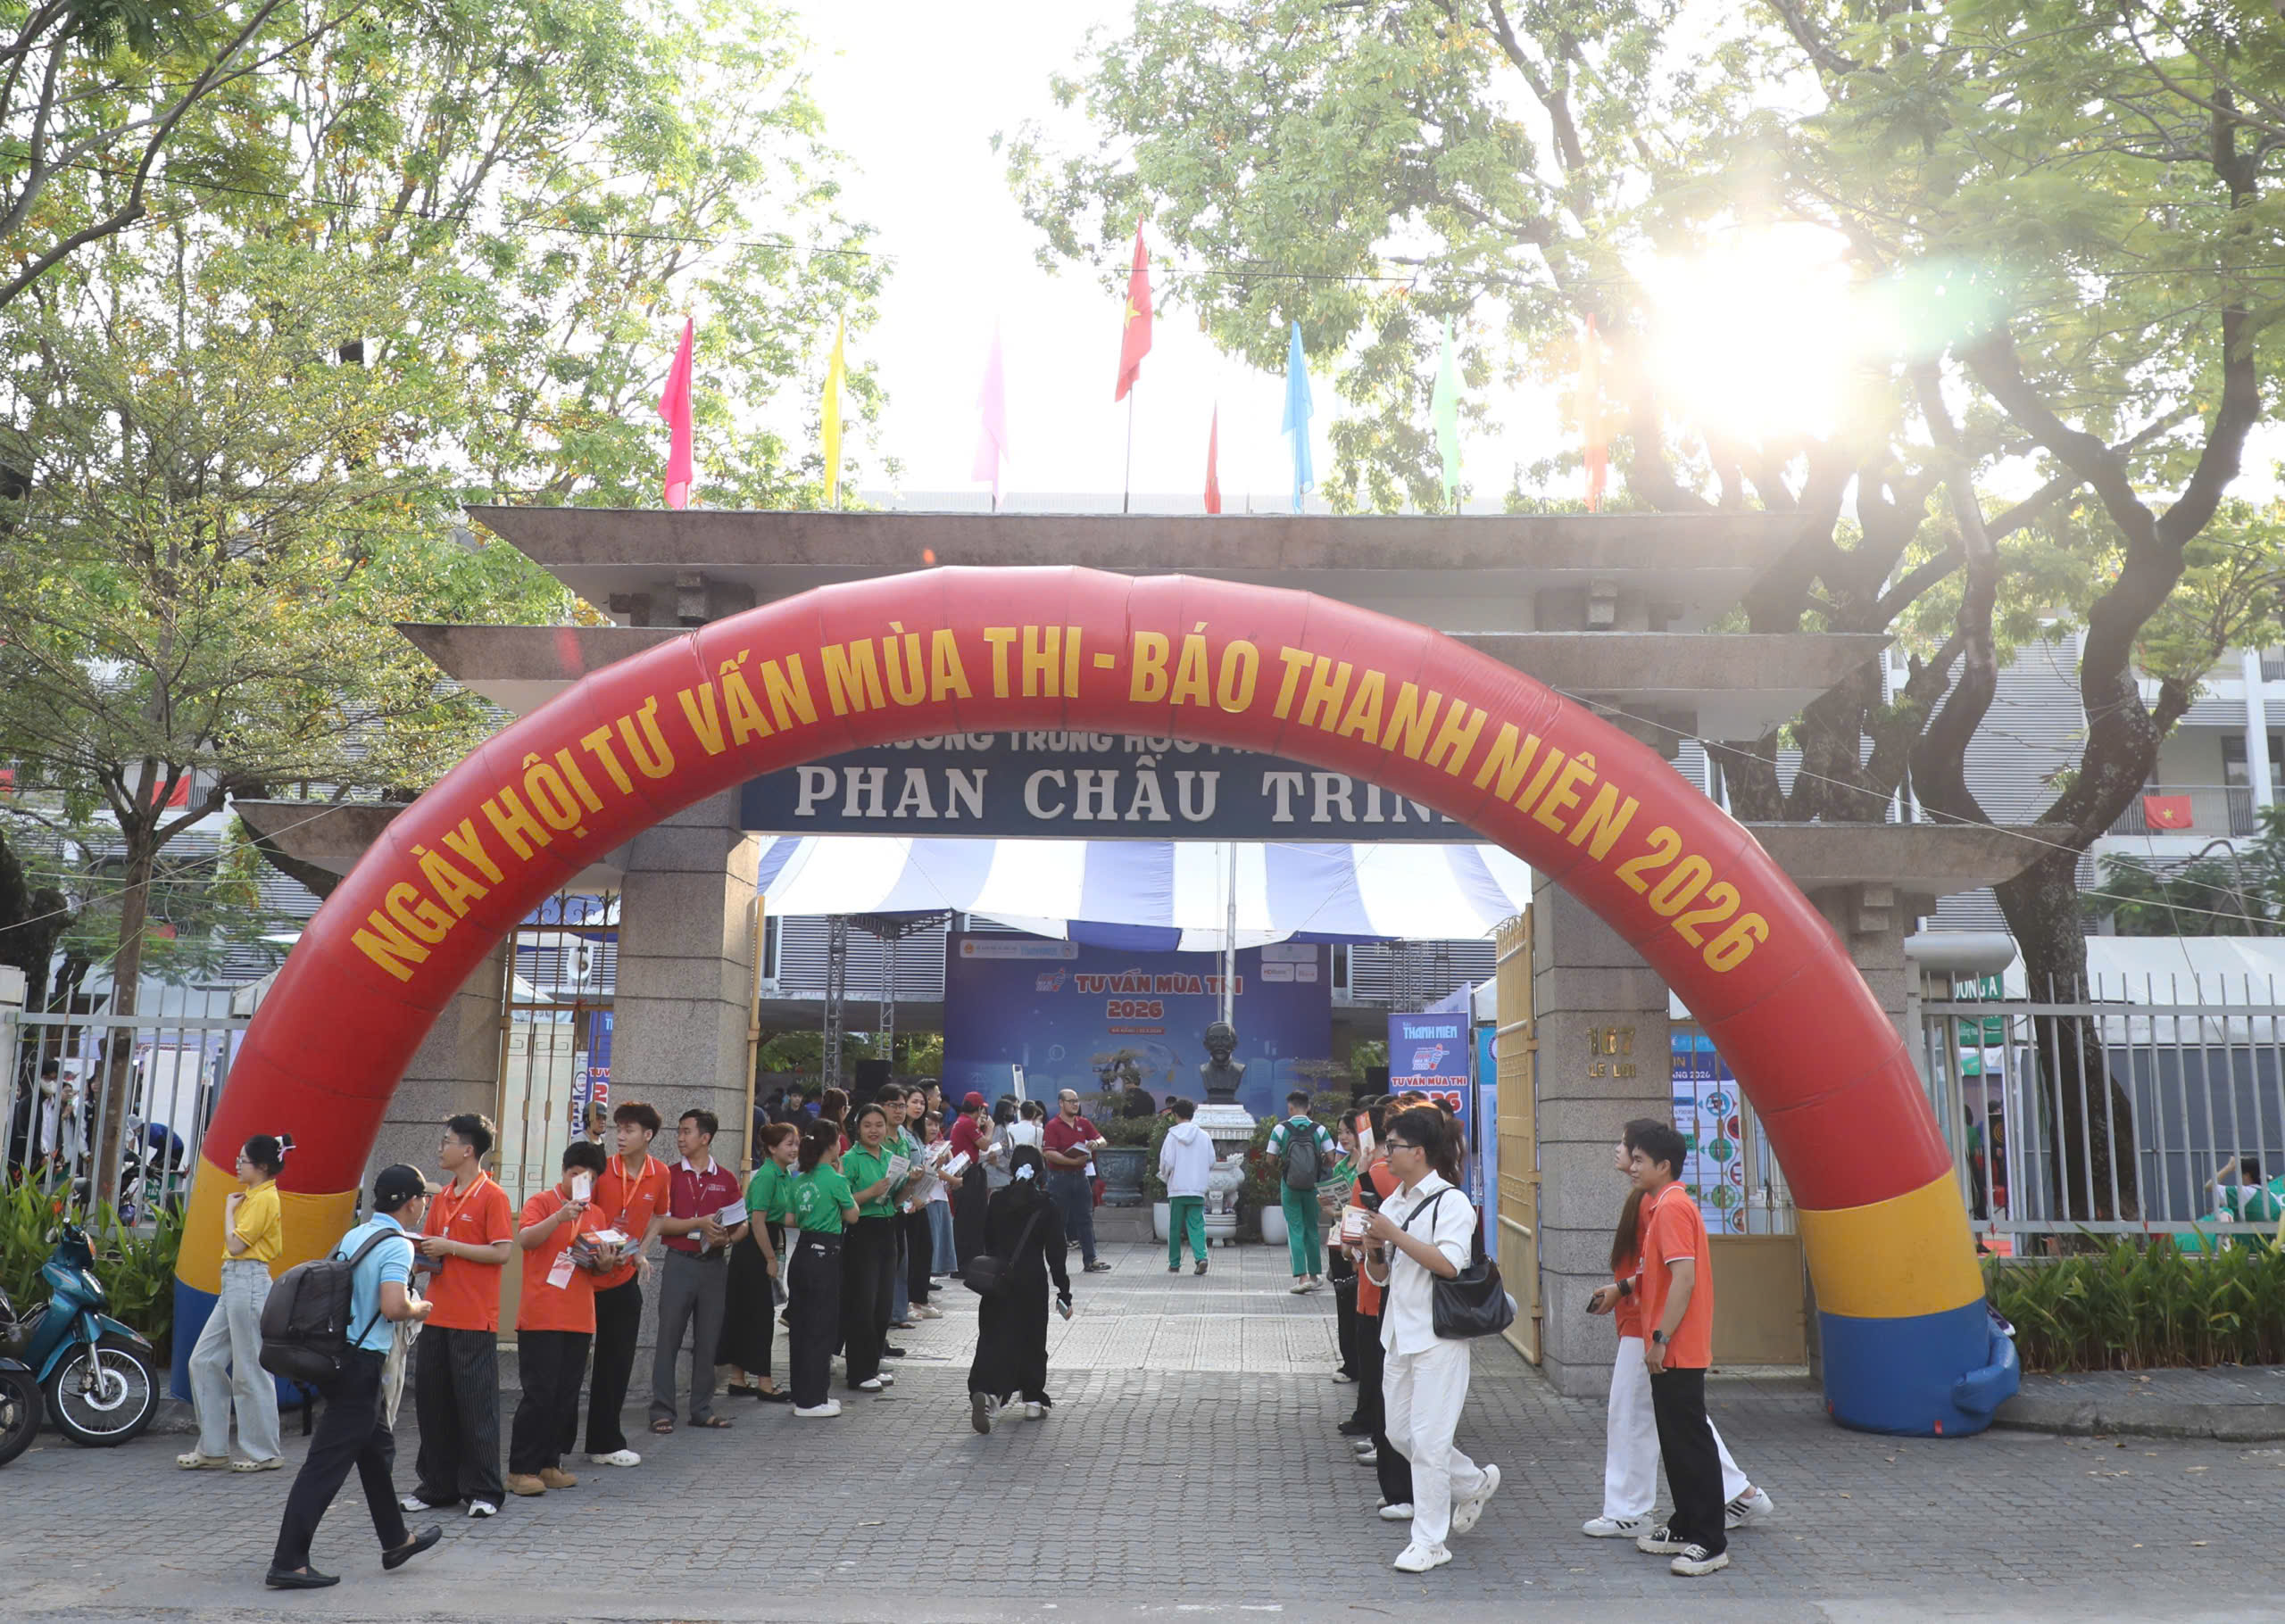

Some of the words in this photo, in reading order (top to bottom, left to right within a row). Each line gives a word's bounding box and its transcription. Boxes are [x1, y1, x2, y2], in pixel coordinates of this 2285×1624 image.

[794, 766, 987, 819] PHAN
[1024, 755, 1220, 822] CHÂU
[1261, 771, 1457, 823] TRIN
[351, 818, 504, 982] NGÀY
[480, 748, 604, 861] HỘI
[580, 696, 676, 794] TƯ
[677, 649, 818, 756] VẤN
[820, 621, 973, 717] MÙA
[984, 626, 1083, 698] THI
[1129, 621, 1259, 713] BÁO
[1272, 646, 1488, 776] THANH
[1472, 722, 1640, 862] NIÊN
[1614, 825, 1769, 973] 2026
[1154, 972, 1204, 995] MÙA
[1107, 999, 1165, 1019] 2026
[1450, 1076, 1467, 1087] THI
